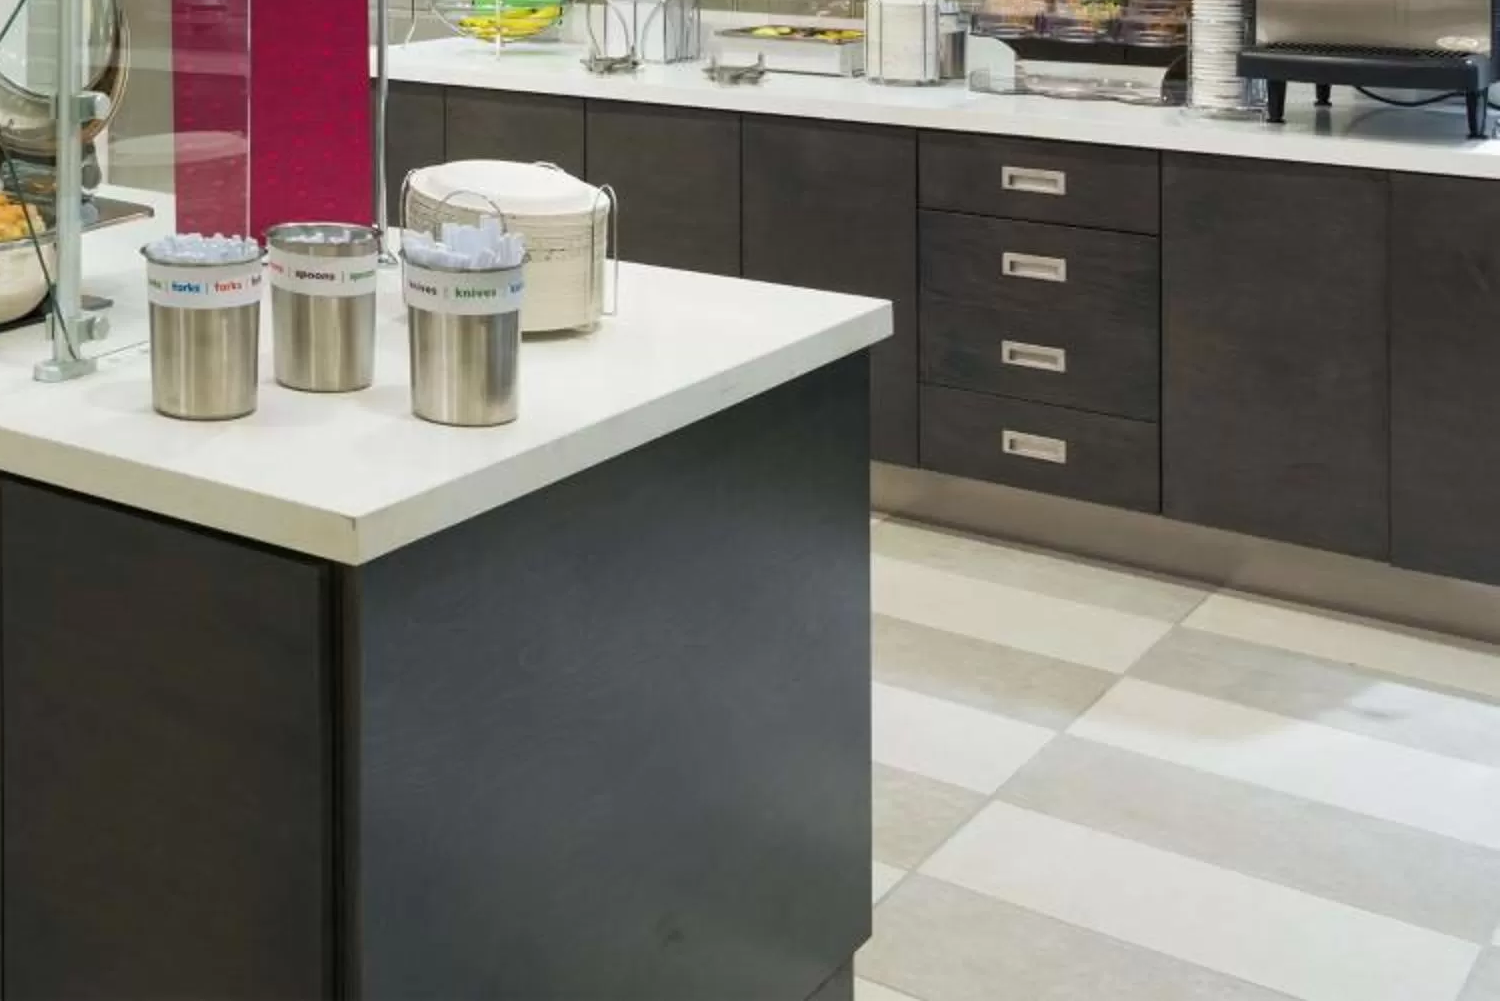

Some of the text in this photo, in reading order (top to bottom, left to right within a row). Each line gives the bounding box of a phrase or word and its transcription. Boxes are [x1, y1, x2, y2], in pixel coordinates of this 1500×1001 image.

[295, 269, 335, 281] spoons
[171, 280, 201, 293] forks
[214, 280, 242, 293] forks
[455, 286, 497, 298] knives
